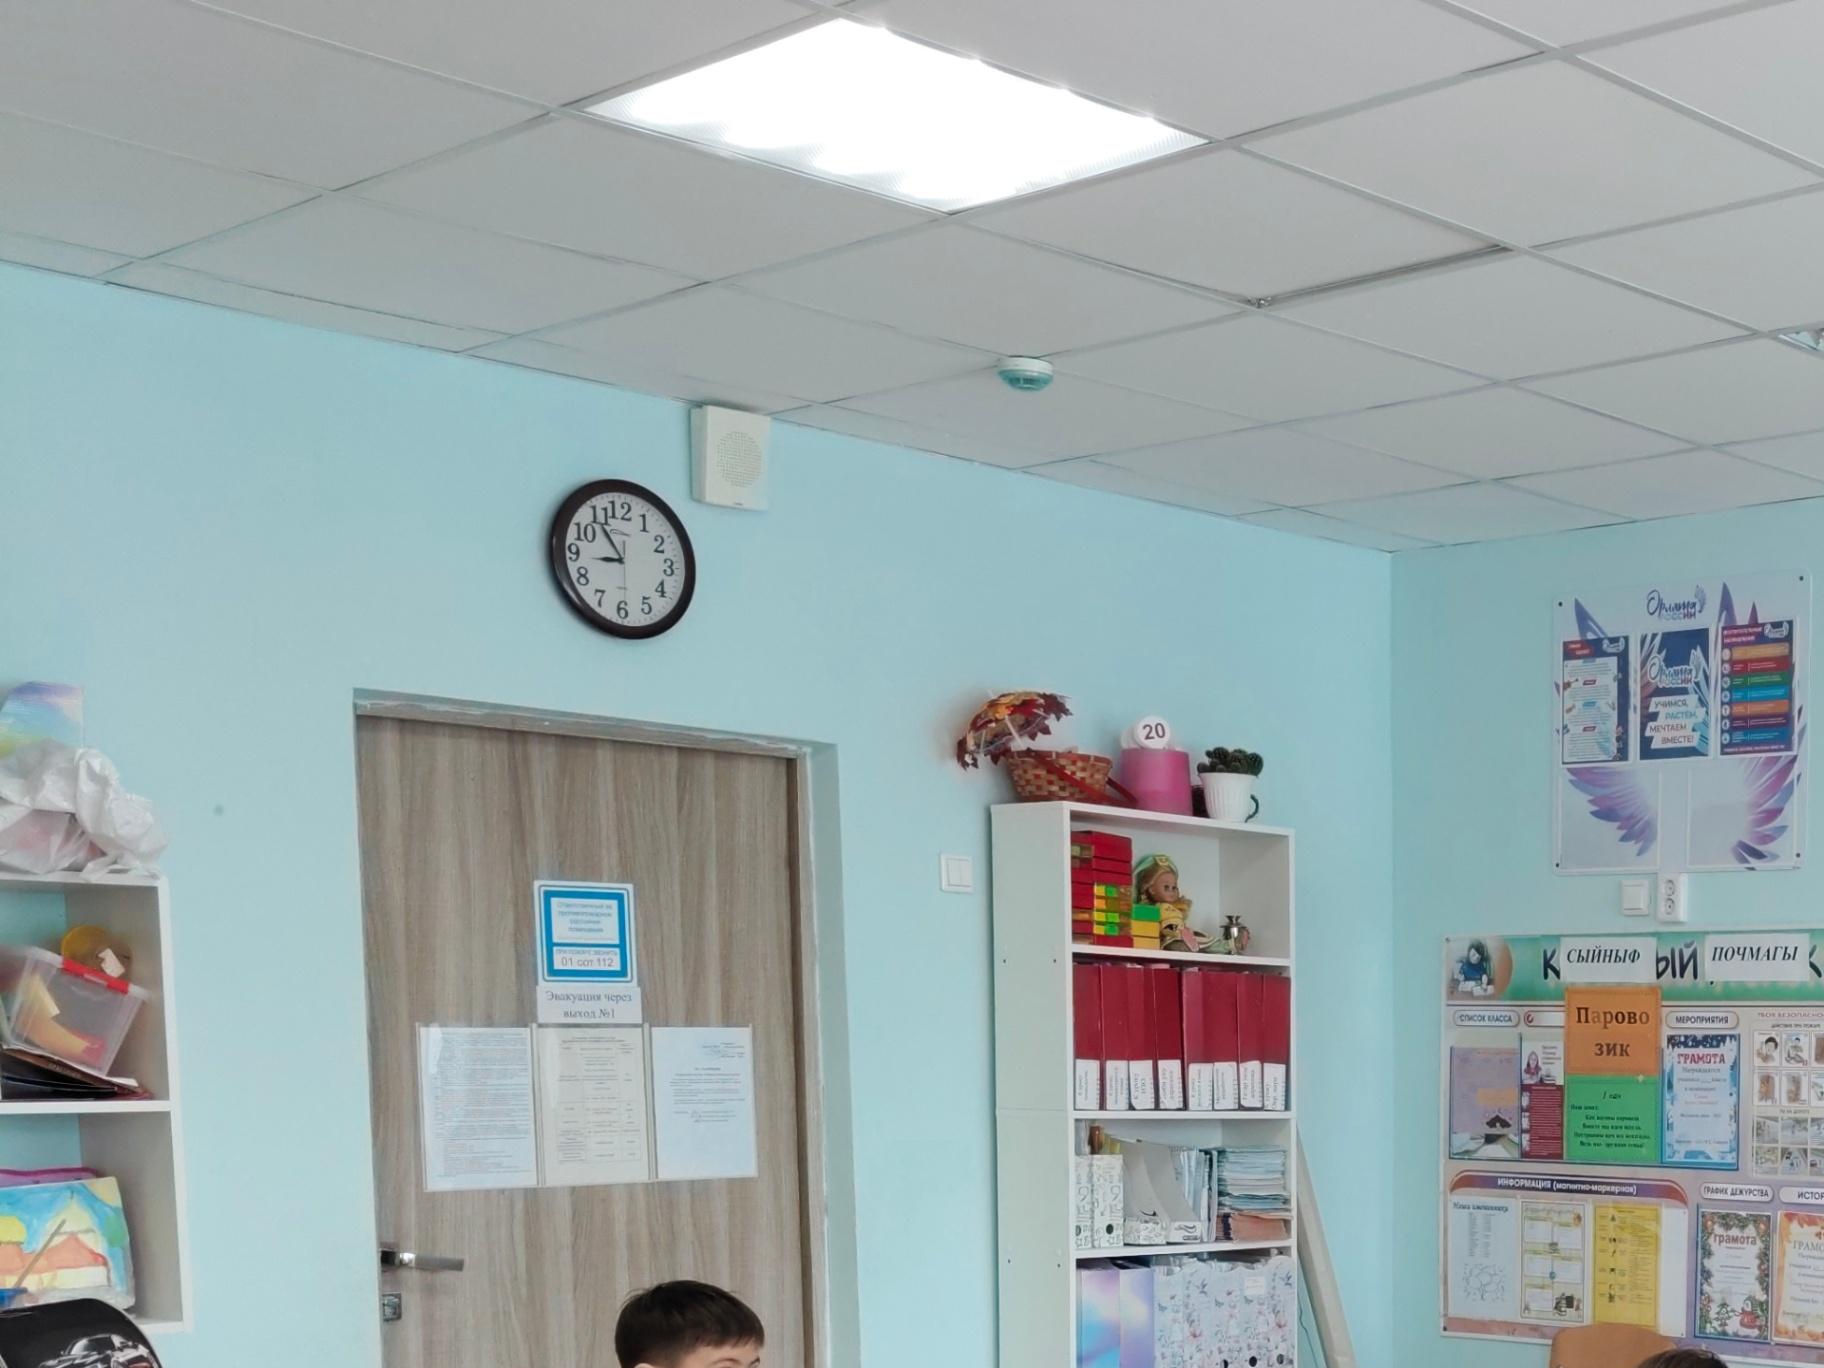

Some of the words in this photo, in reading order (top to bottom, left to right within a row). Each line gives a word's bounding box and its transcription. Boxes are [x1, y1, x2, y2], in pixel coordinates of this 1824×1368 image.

[591, 505, 609, 526] 11
[608, 500, 632, 522] 12
[575, 522, 596, 543] 10
[640, 514, 649, 533] 1
[568, 543, 580, 562] 9
[654, 535, 665, 553] 2
[577, 567, 589, 585] 8
[663, 559, 674, 576] 3
[655, 580, 666, 597] 4
[595, 589, 606, 607] 7
[641, 596, 652, 614] 5
[617, 601, 628, 619] 6
[1142, 722, 1166, 740] 20
[561, 957, 573, 966] 01
[597, 958, 614, 967] 112
[1566, 945, 1641, 965] СЫЙНЫФ
[1711, 945, 1799, 962] ПОЧМАГЫ
[546, 991, 601, 1003] Эвакуация
[605, 994, 632, 1004] через
[563, 1010, 597, 1019] выход
[1459, 1014, 1487, 1023] СПИСОК
[1487, 1014, 1513, 1023] КЛАССА
[1575, 1006, 1650, 1029] Парово
[1675, 1015, 1729, 1025] МЕРОПРИЯТИЯ
[1677, 1053, 1726, 1065] ГРАМОТА
[1497, 1177, 1552, 1189] ИНФОРМАЦИЯ
[1553, 1180, 1638, 1195] (магнитно-маркерная)
[1703, 1185, 1729, 1196] ГРАФИК
[1730, 1187, 1769, 1197] ДЕЖУРСТВА
[1713, 1233, 1757, 1246] грамота
